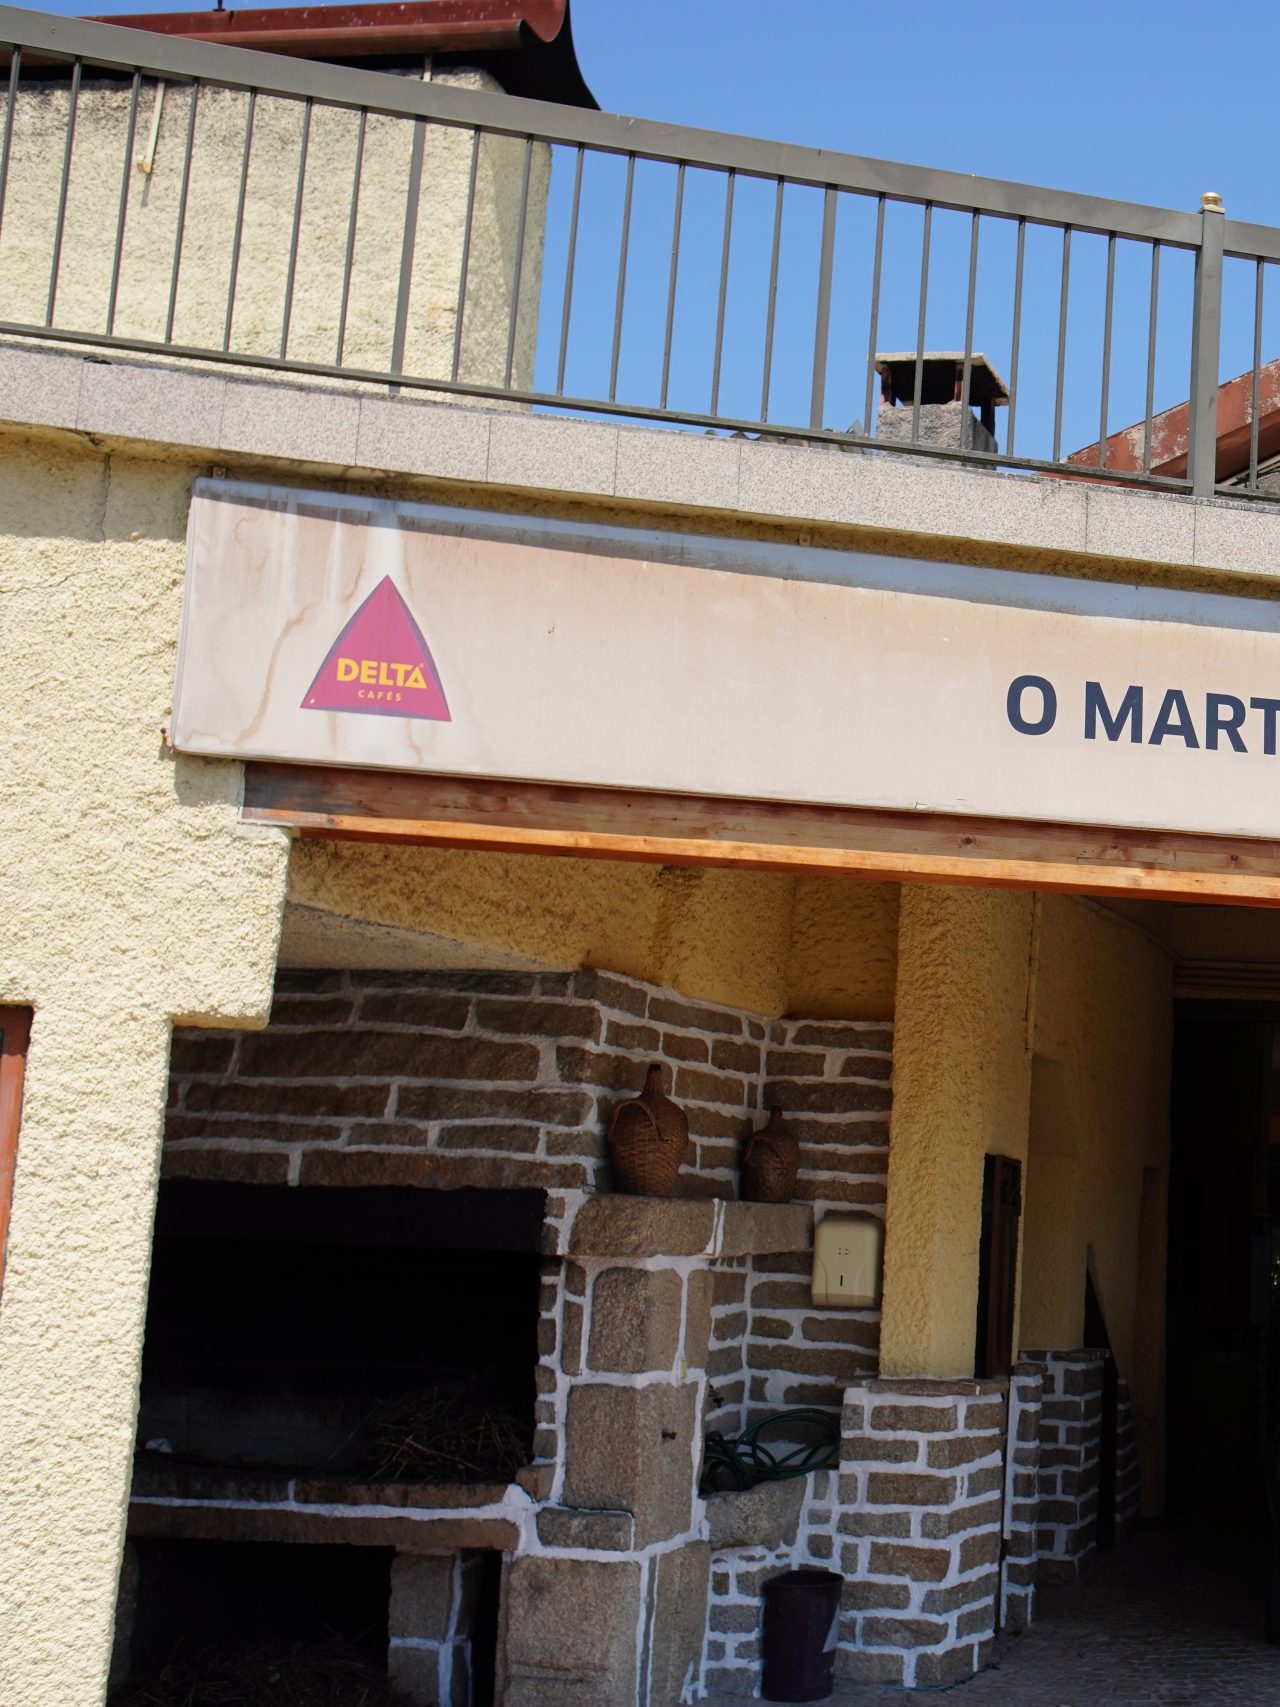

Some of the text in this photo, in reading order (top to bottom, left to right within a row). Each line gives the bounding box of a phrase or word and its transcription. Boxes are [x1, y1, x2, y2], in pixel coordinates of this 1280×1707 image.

[337, 657, 427, 689] DELTA
[358, 689, 402, 702] CAFÉS
[1006, 675, 1057, 736] O
